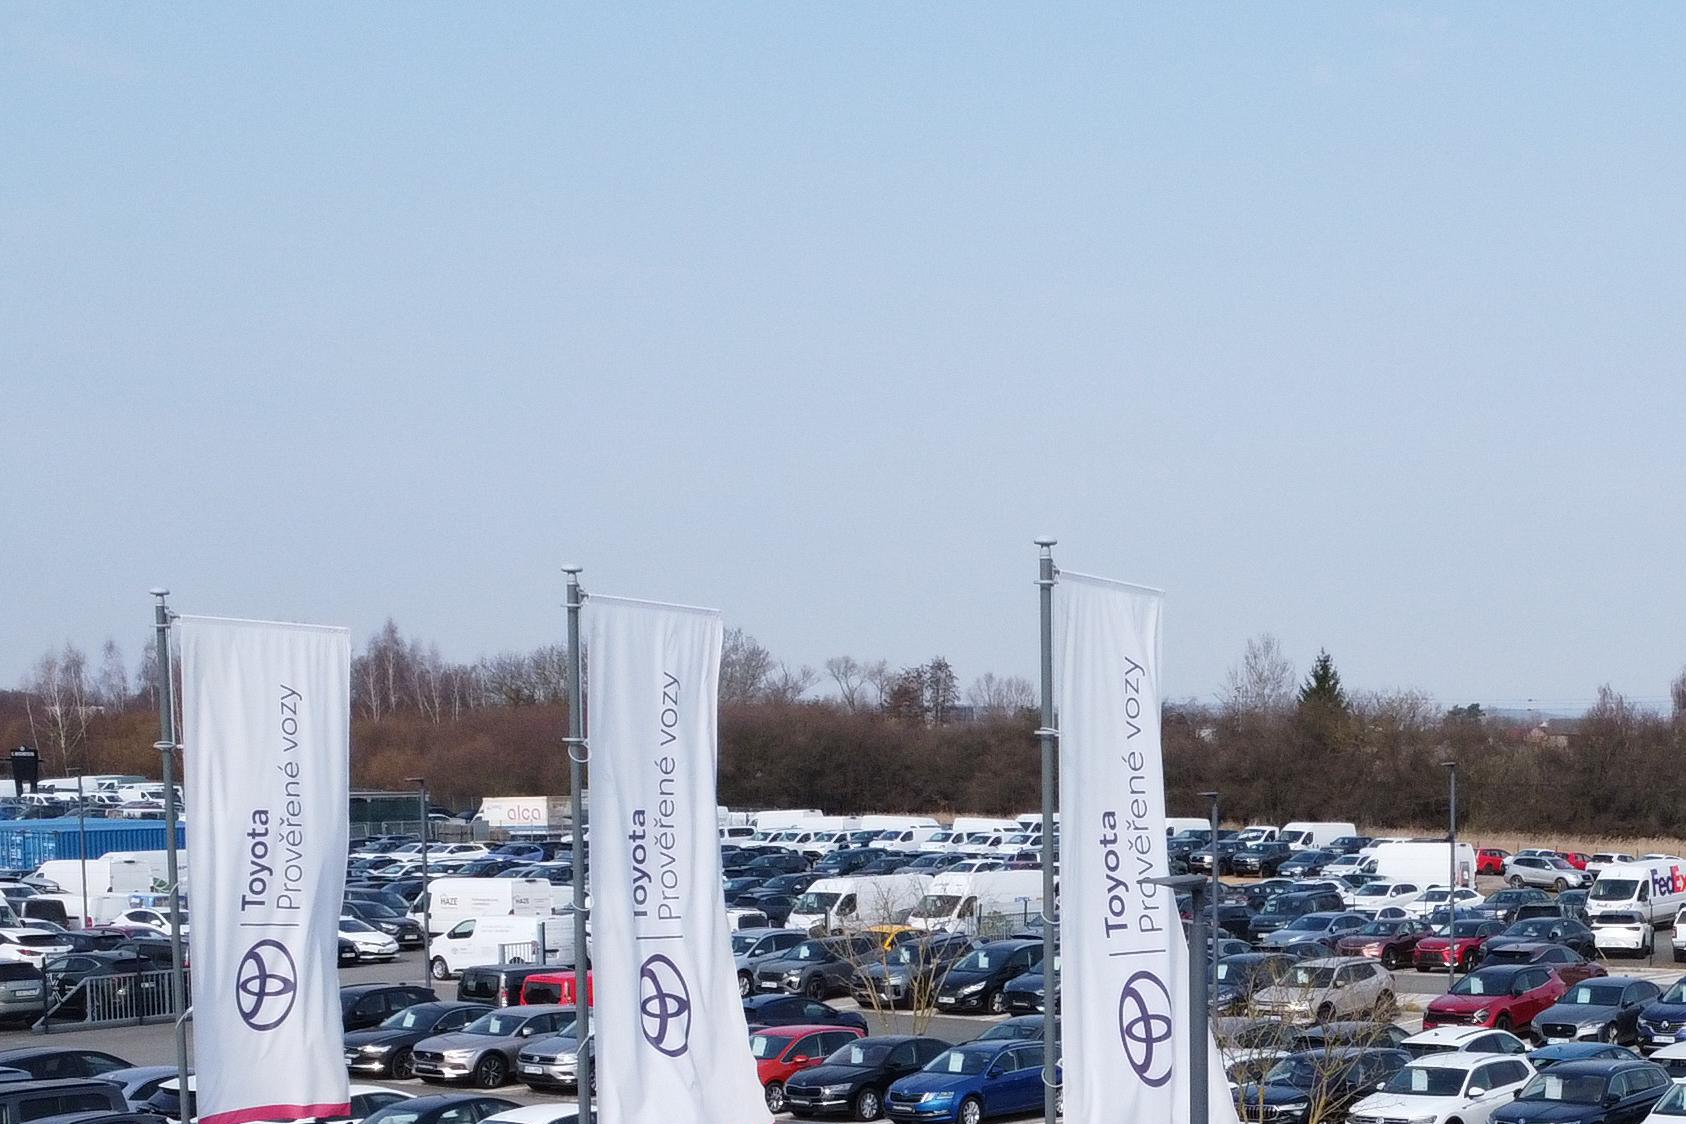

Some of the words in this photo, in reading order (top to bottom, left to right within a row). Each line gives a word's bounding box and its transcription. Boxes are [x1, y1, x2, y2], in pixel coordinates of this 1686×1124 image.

[280, 684, 302, 752] vozy
[660, 672, 681, 746] vozy
[1124, 656, 1145, 740] vozy
[277, 762, 304, 910] Prověřené
[507, 804, 541, 821] alca
[654, 757, 682, 921] Prověřené
[1121, 751, 1163, 933] Prověřené
[240, 809, 273, 911] Toyota
[440, 895, 458, 906] HAZE
[1100, 811, 1129, 938] Toyota
